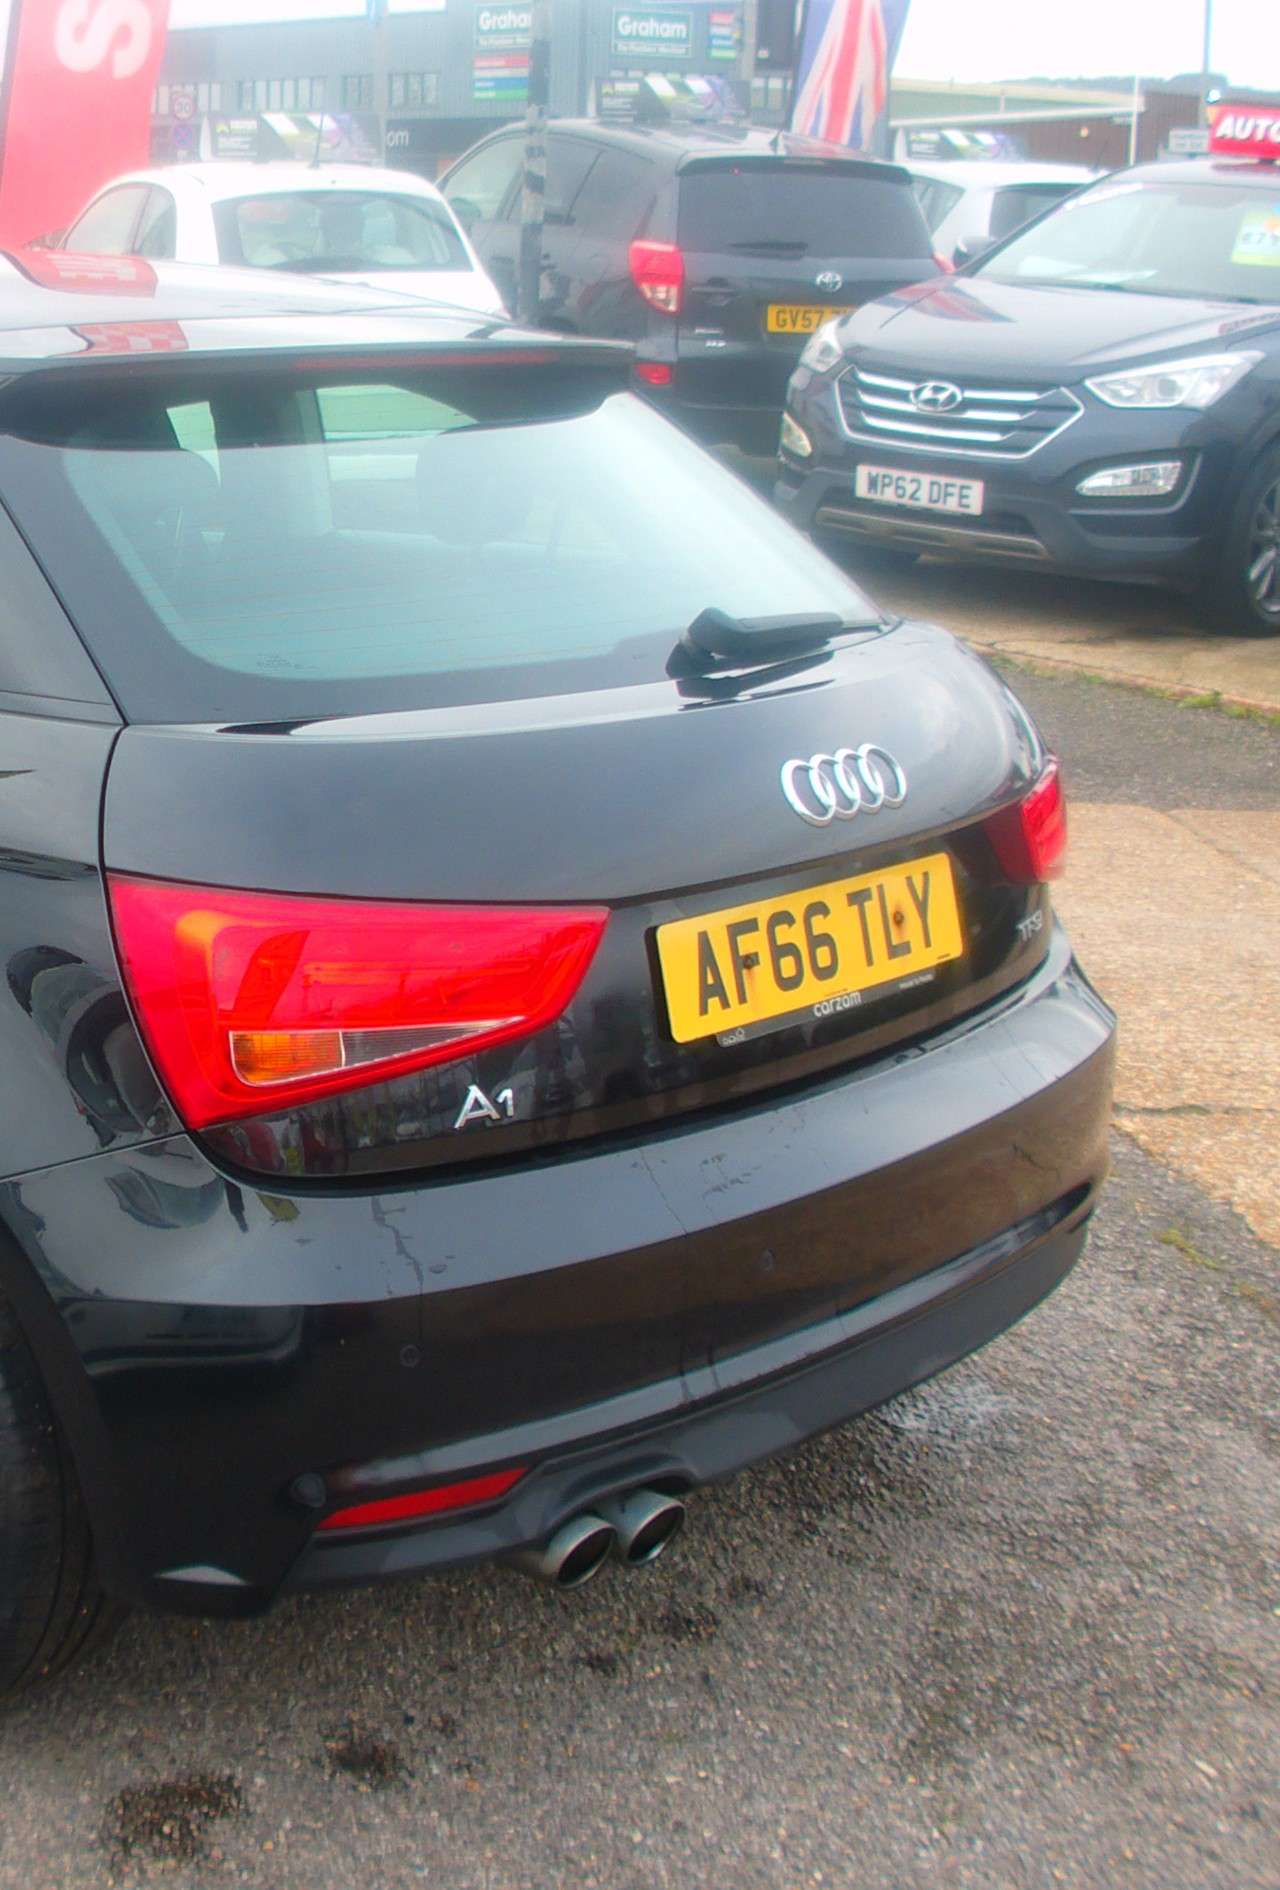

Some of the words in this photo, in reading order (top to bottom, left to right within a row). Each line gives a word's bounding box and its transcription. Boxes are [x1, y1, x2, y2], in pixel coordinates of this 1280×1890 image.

[618, 16, 687, 39] Graham
[866, 471, 922, 501] WP62
[928, 480, 972, 509] DFE
[697, 900, 839, 1016] AF66
[846, 871, 932, 967] TLY
[454, 1084, 514, 1129] A1
